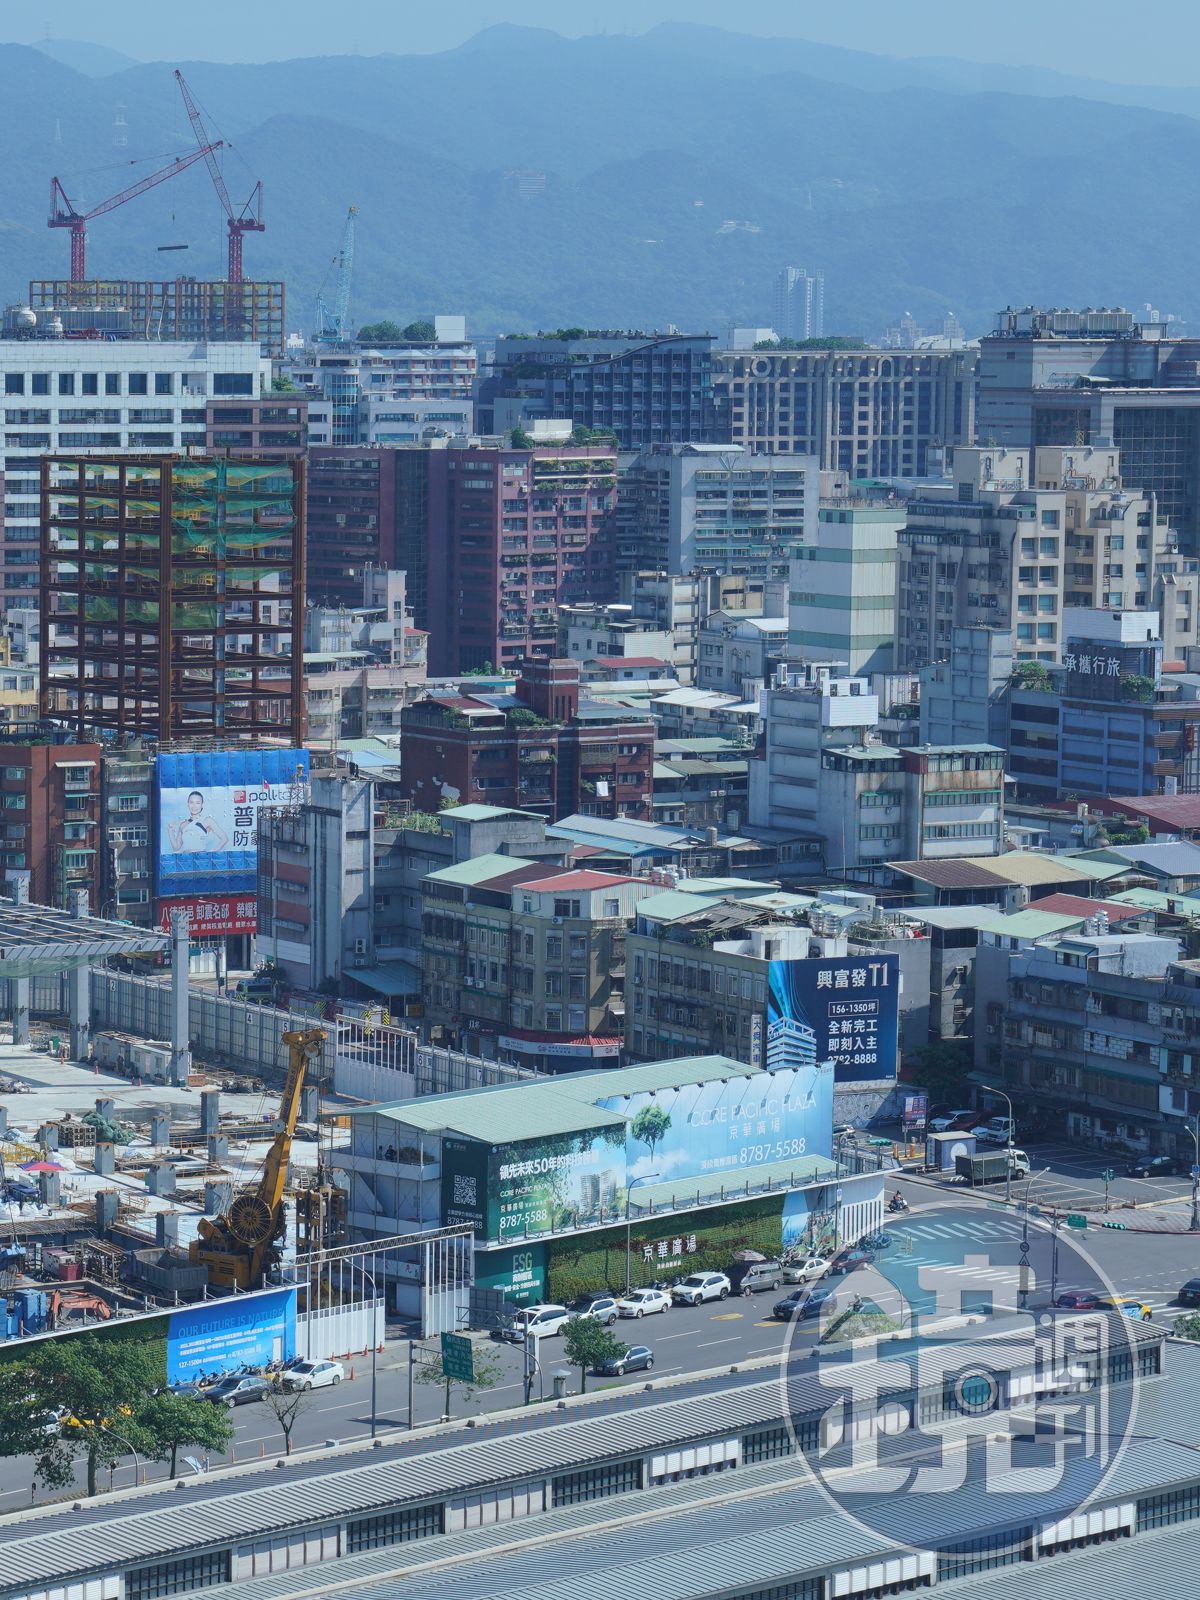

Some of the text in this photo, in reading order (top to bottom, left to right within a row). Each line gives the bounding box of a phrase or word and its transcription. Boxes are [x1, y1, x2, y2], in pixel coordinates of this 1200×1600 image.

[1064, 653, 1121, 677] 承攜行旅
[831, 1002, 876, 1014] 156-1350坪
[828, 1019, 878, 1035] 全新完工
[828, 1036, 878, 1052] 即刻入主
[739, 1138, 806, 1164] 8787-5588
[499, 1209, 548, 1229] 8787-5588
[512, 1251, 533, 1273] ESG
[178, 1325, 199, 1337] OUR
[201, 1317, 236, 1333] FUTURE
[239, 1316, 246, 1326] IS
[248, 1308, 284, 1325] NATURE
